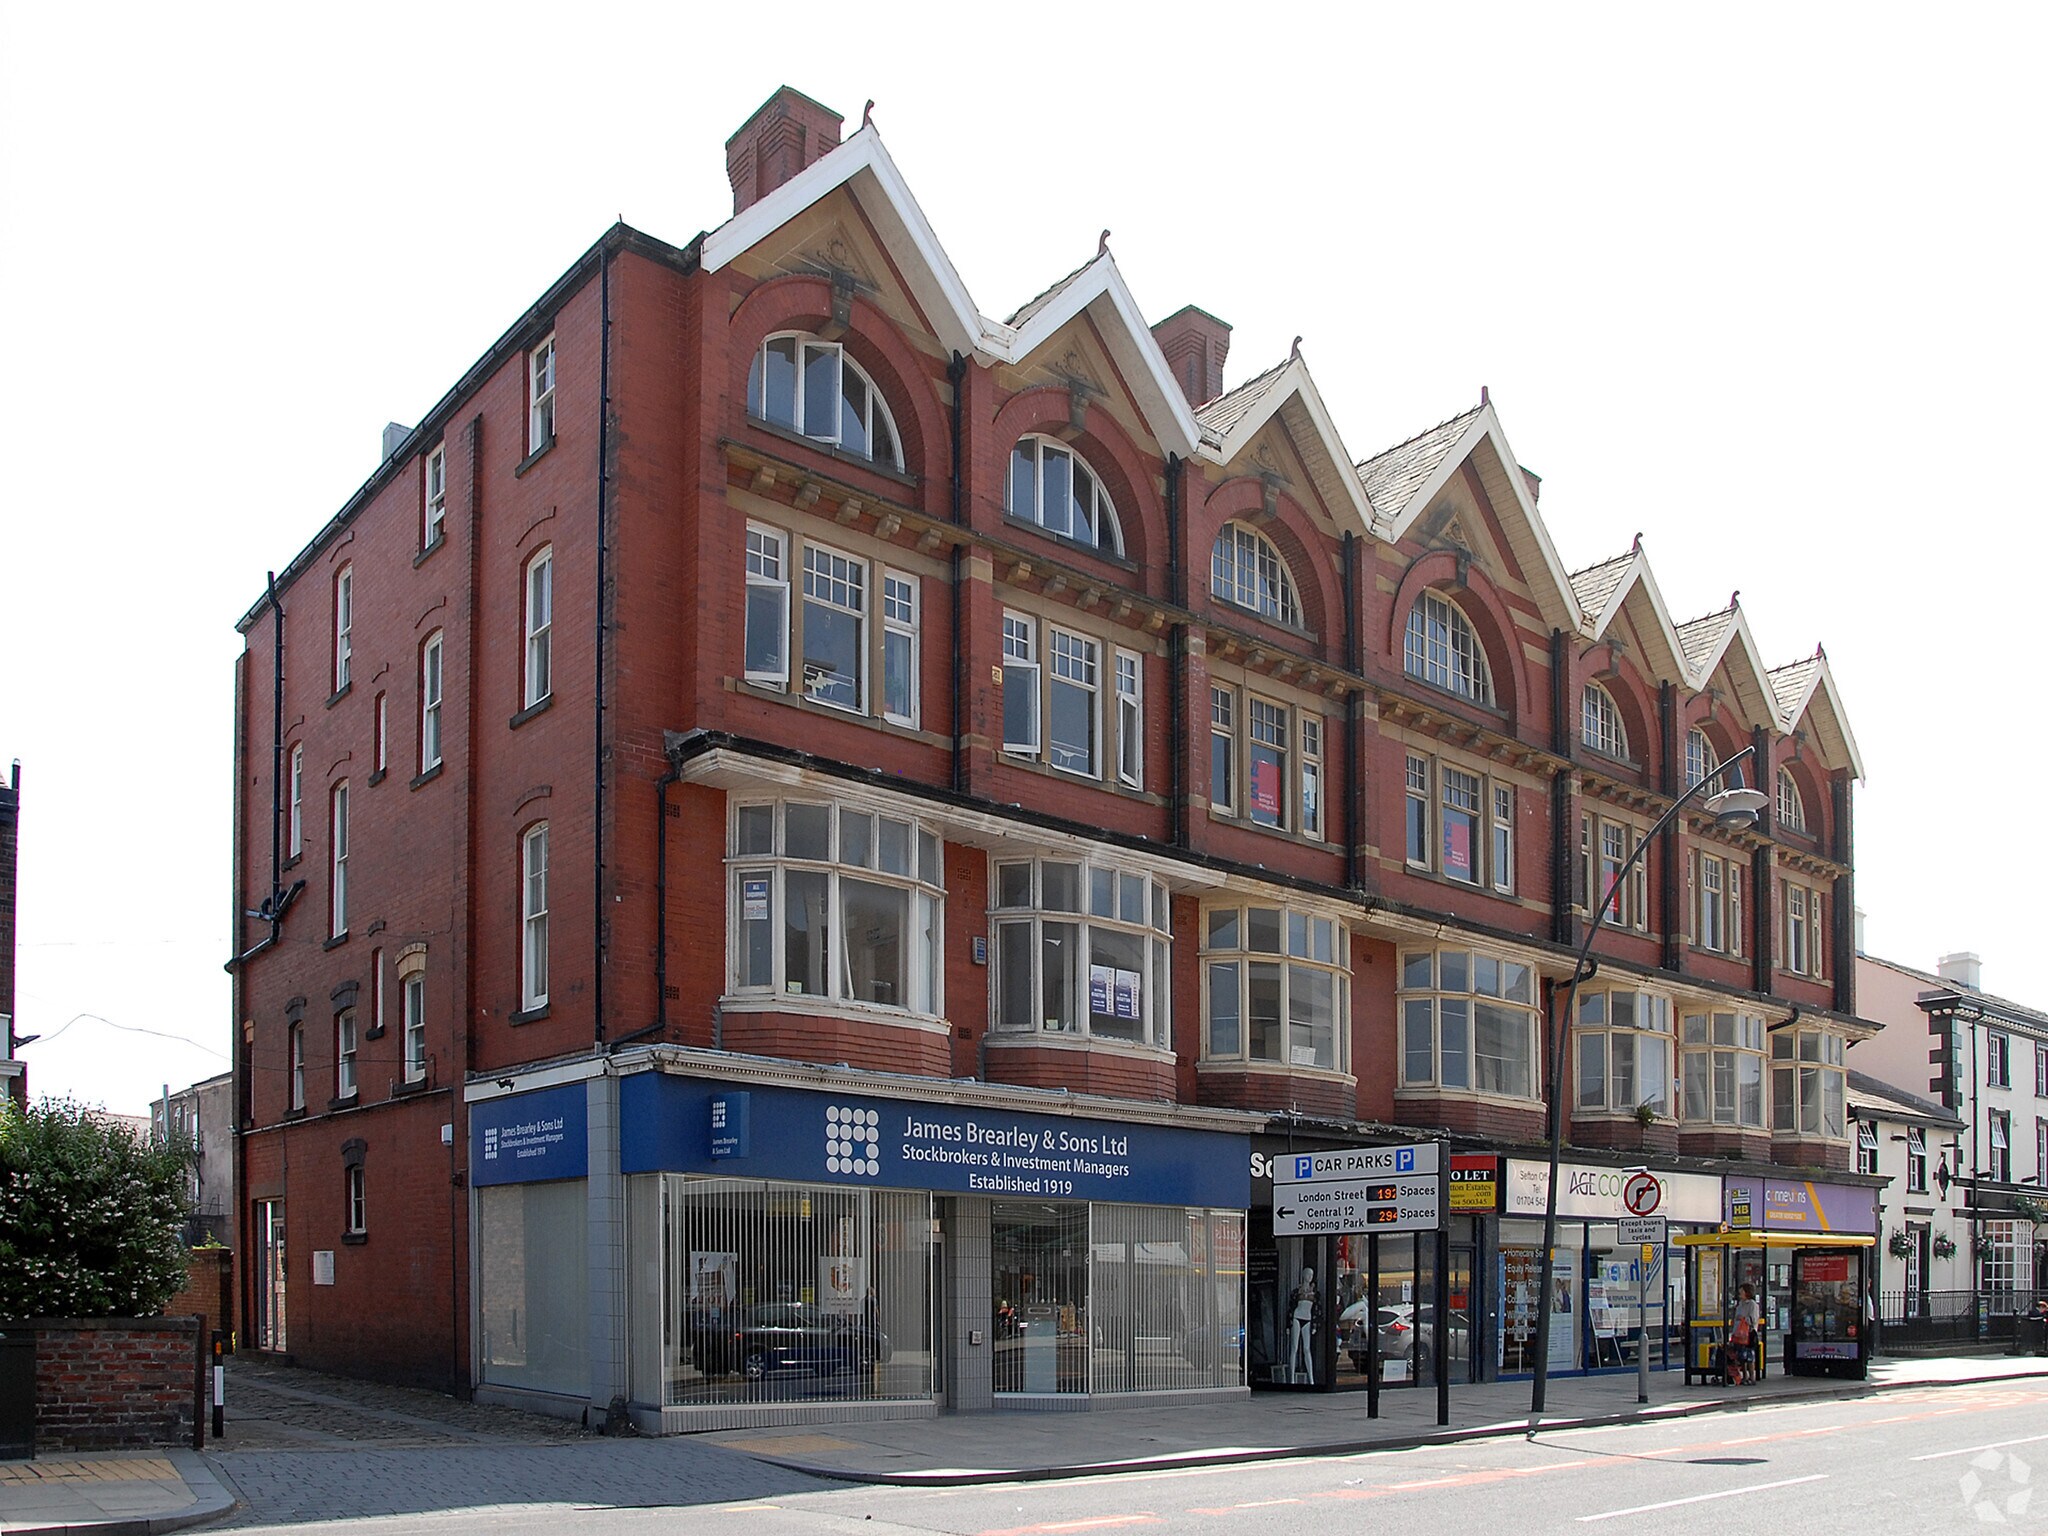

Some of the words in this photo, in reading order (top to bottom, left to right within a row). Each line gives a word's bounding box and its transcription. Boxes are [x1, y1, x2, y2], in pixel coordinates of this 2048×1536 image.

[501, 1127, 516, 1138] James
[517, 1123, 536, 1136] Brearley
[541, 1120, 553, 1132] Sons
[554, 1117, 563, 1129] Ltd
[903, 1116, 961, 1142] James
[966, 1121, 1038, 1153] Brearley
[1043, 1130, 1055, 1150] &
[1059, 1131, 1098, 1155] Sons
[1102, 1134, 1128, 1156] Ltd
[517, 1148, 537, 1158] Established
[902, 1144, 988, 1167] Stockbrokers
[991, 1152, 1000, 1167] &
[1003, 1153, 1071, 1173] Investment
[1073, 1158, 1129, 1178] Managers
[1315, 1158, 1342, 1172] CAR
[1347, 1154, 1392, 1169] PARKS
[1450, 1170, 1461, 1181] O
[1464, 1170, 1490, 1180] LET
[969, 1174, 1040, 1193] Established
[1043, 1179, 1072, 1195] 1919
[1466, 1183, 1491, 1191] Estates
[1569, 1171, 1596, 1196] AGE
[1599, 1174, 1669, 1200] conn
[1298, 1192, 1331, 1203] London
[1334, 1189, 1364, 1201] Street
[1400, 1185, 1436, 1198] Spaces
[1516, 1195, 1534, 1206] 01704
[1535, 1197, 1546, 1207] 542
[1307, 1208, 1341, 1218] Central
[1343, 1206, 1354, 1217] 12
[1400, 1208, 1436, 1219] Spaces
[1734, 1205, 1749, 1214] HB
[1297, 1220, 1339, 1231] Shopping
[1343, 1218, 1365, 1228] Park
[1507, 1248, 1534, 1257] Homecare
[1507, 1264, 1524, 1275] Equity
[1525, 1264, 1543, 1273] Releas
